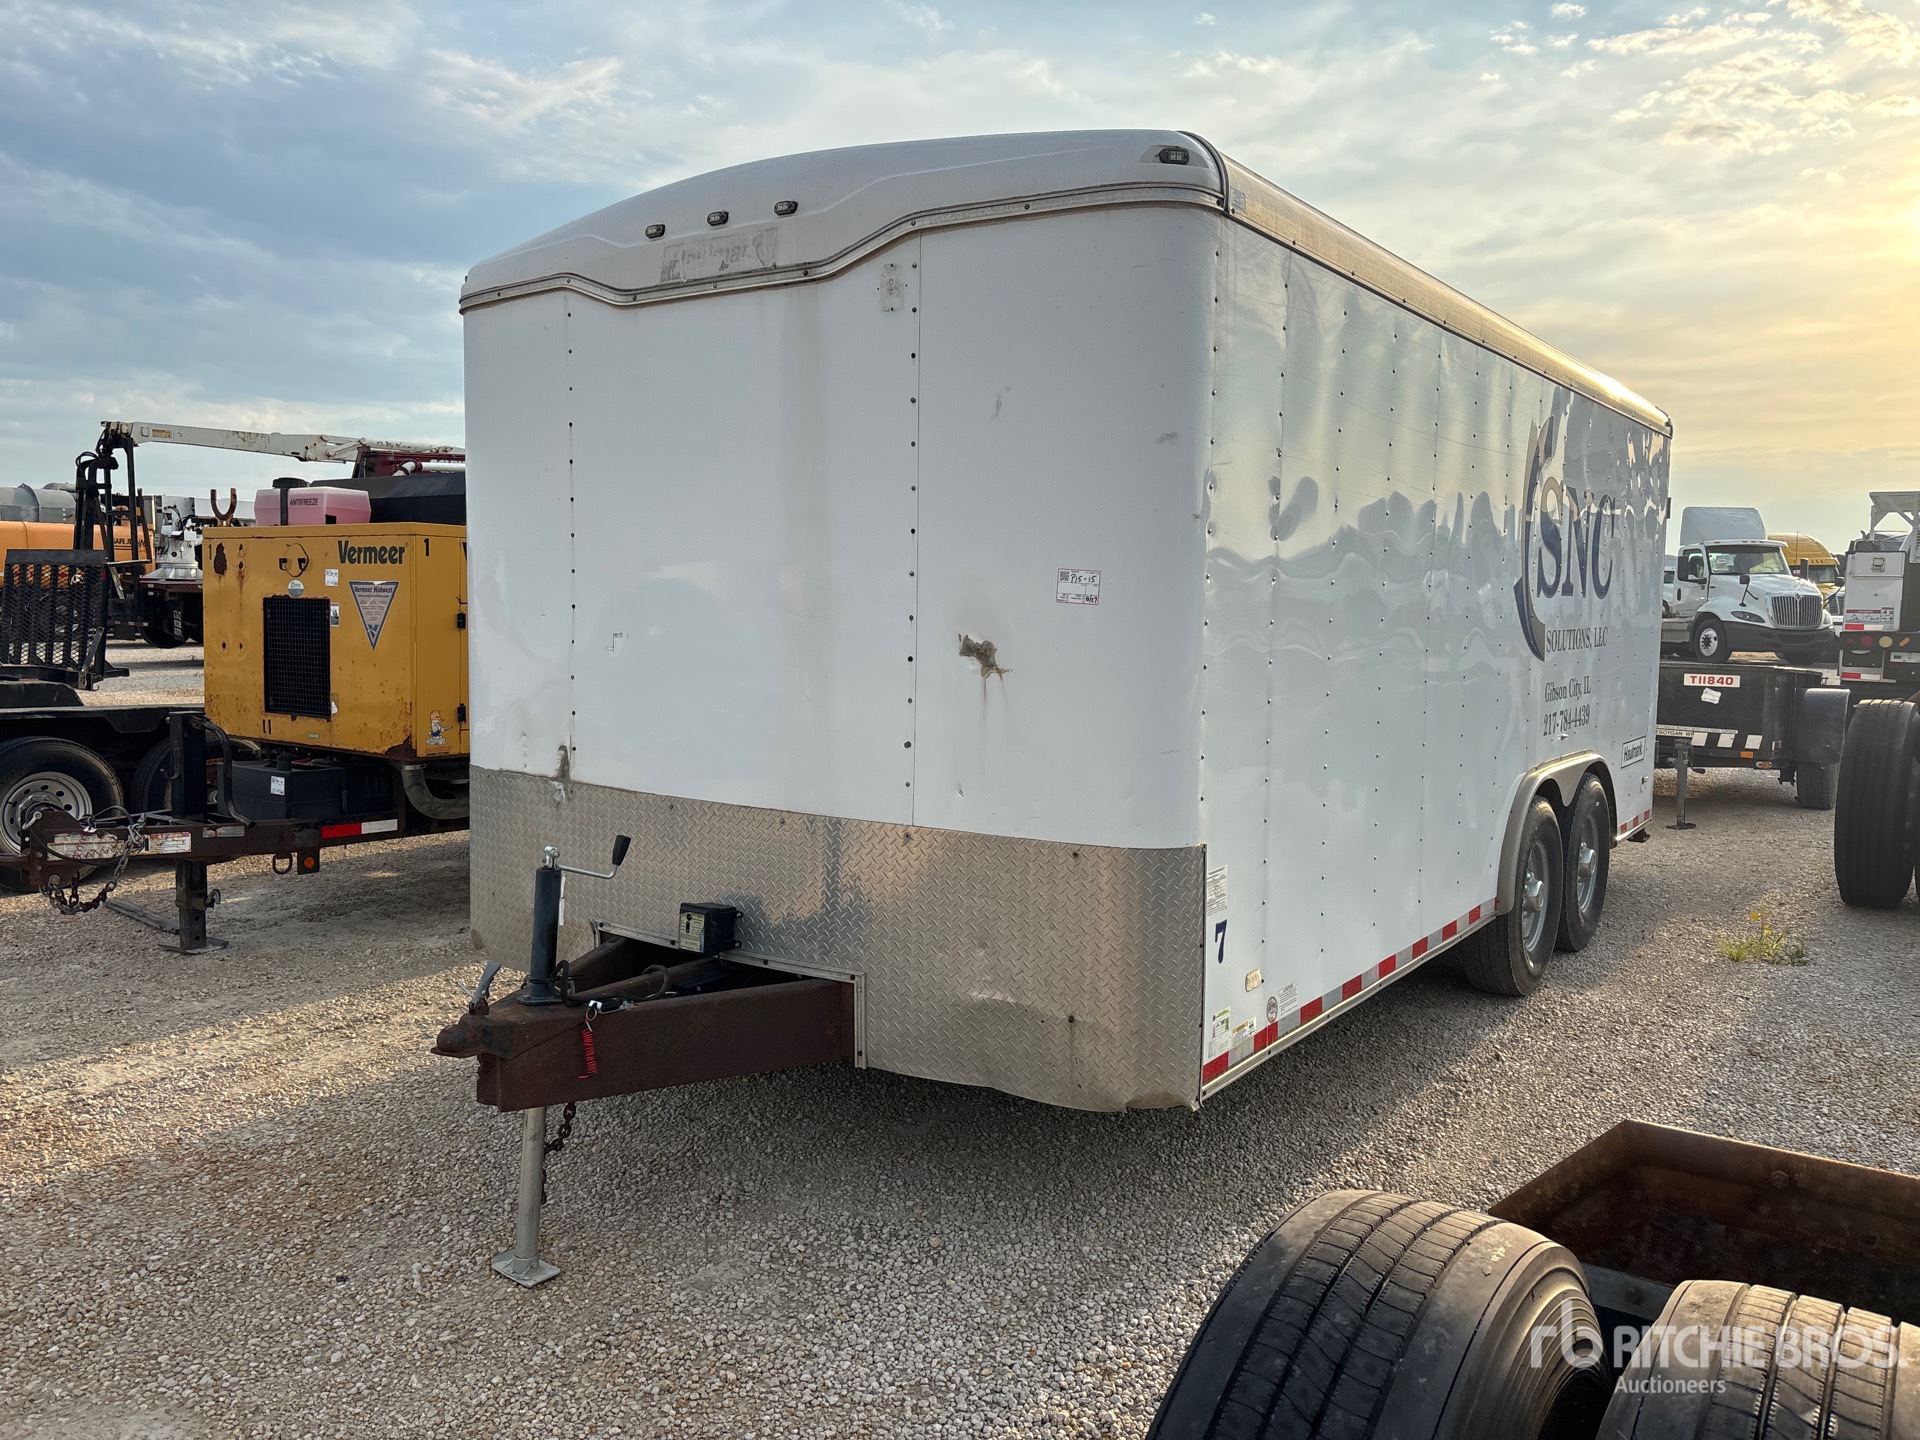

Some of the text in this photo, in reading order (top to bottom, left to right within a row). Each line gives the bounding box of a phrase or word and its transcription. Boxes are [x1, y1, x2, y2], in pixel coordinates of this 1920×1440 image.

[289, 498, 319, 506] ANTIFREEZE
[423, 538, 430, 557] 1
[1536, 476, 1616, 600] SNC
[338, 540, 405, 565] Vermeer
[1546, 627, 1593, 653] SOLUTIONS,
[1544, 682, 1568, 703] Gibson
[1583, 675, 1592, 695] IL
[1543, 704, 1591, 737] 217-784-4439
[1214, 919, 1228, 964] 7
